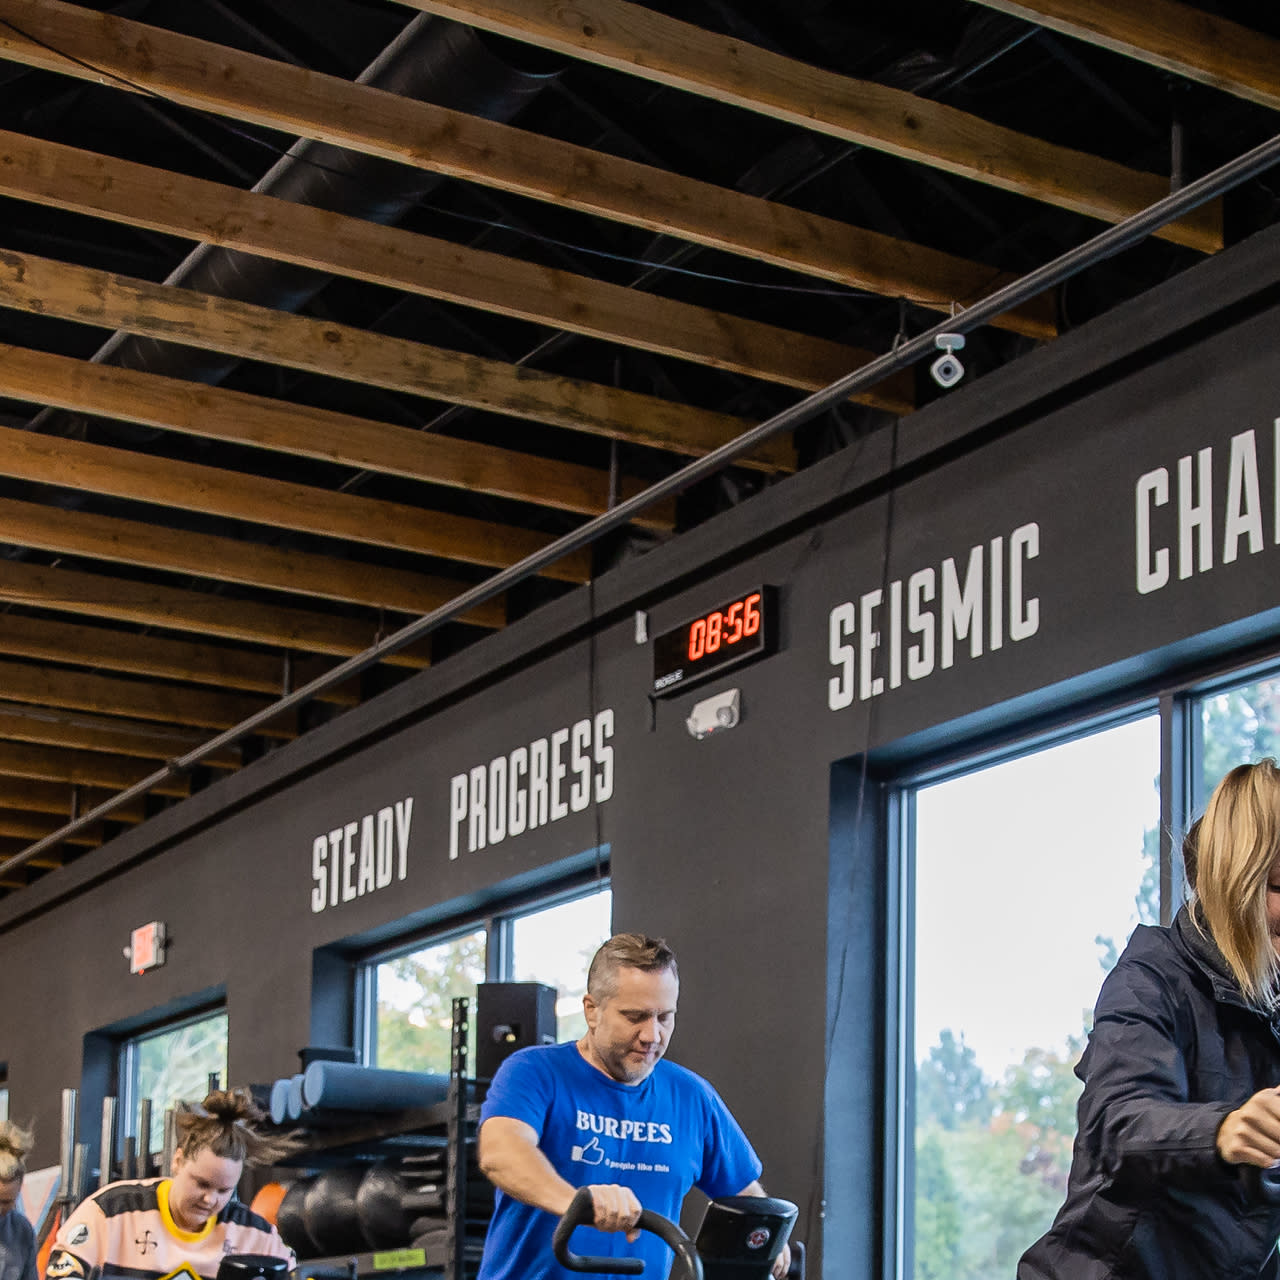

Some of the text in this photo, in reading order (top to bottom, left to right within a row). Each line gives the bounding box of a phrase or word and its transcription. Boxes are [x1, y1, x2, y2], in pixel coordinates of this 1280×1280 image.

[688, 593, 761, 661] 08:56
[828, 522, 1041, 711] SEISMIC
[311, 708, 616, 914] STEADY PROGRESS
[576, 1109, 673, 1145] BURPEES
